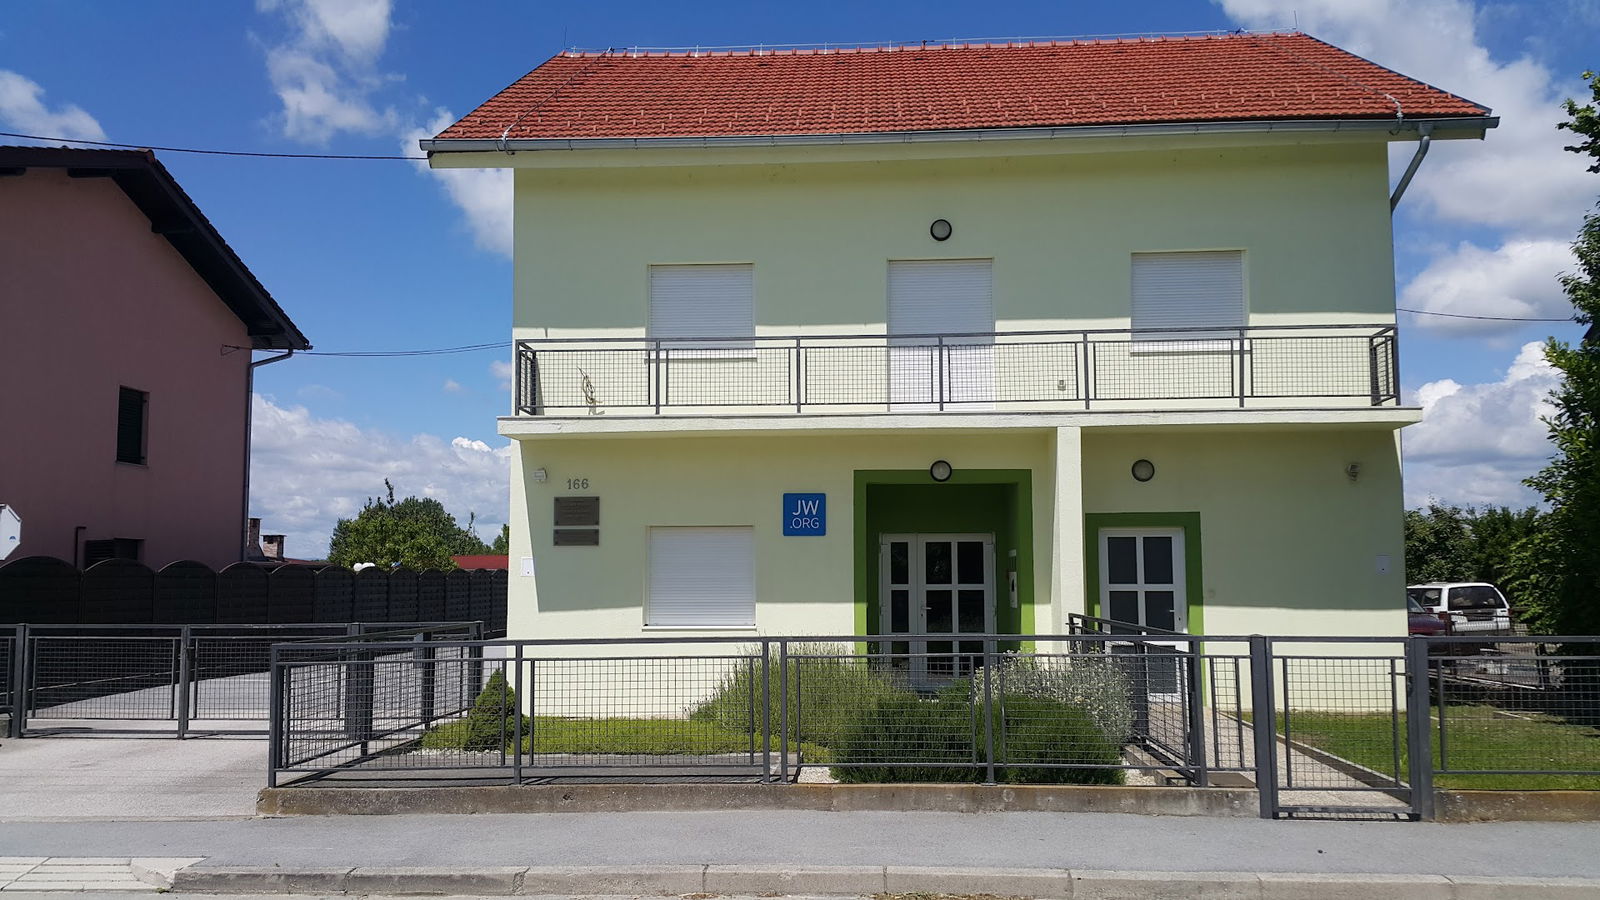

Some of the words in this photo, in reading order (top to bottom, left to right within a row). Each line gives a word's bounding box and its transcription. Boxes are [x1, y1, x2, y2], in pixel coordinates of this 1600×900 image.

[567, 478, 589, 490] 166
[792, 499, 819, 516] JW
[789, 517, 820, 529] .ORG
